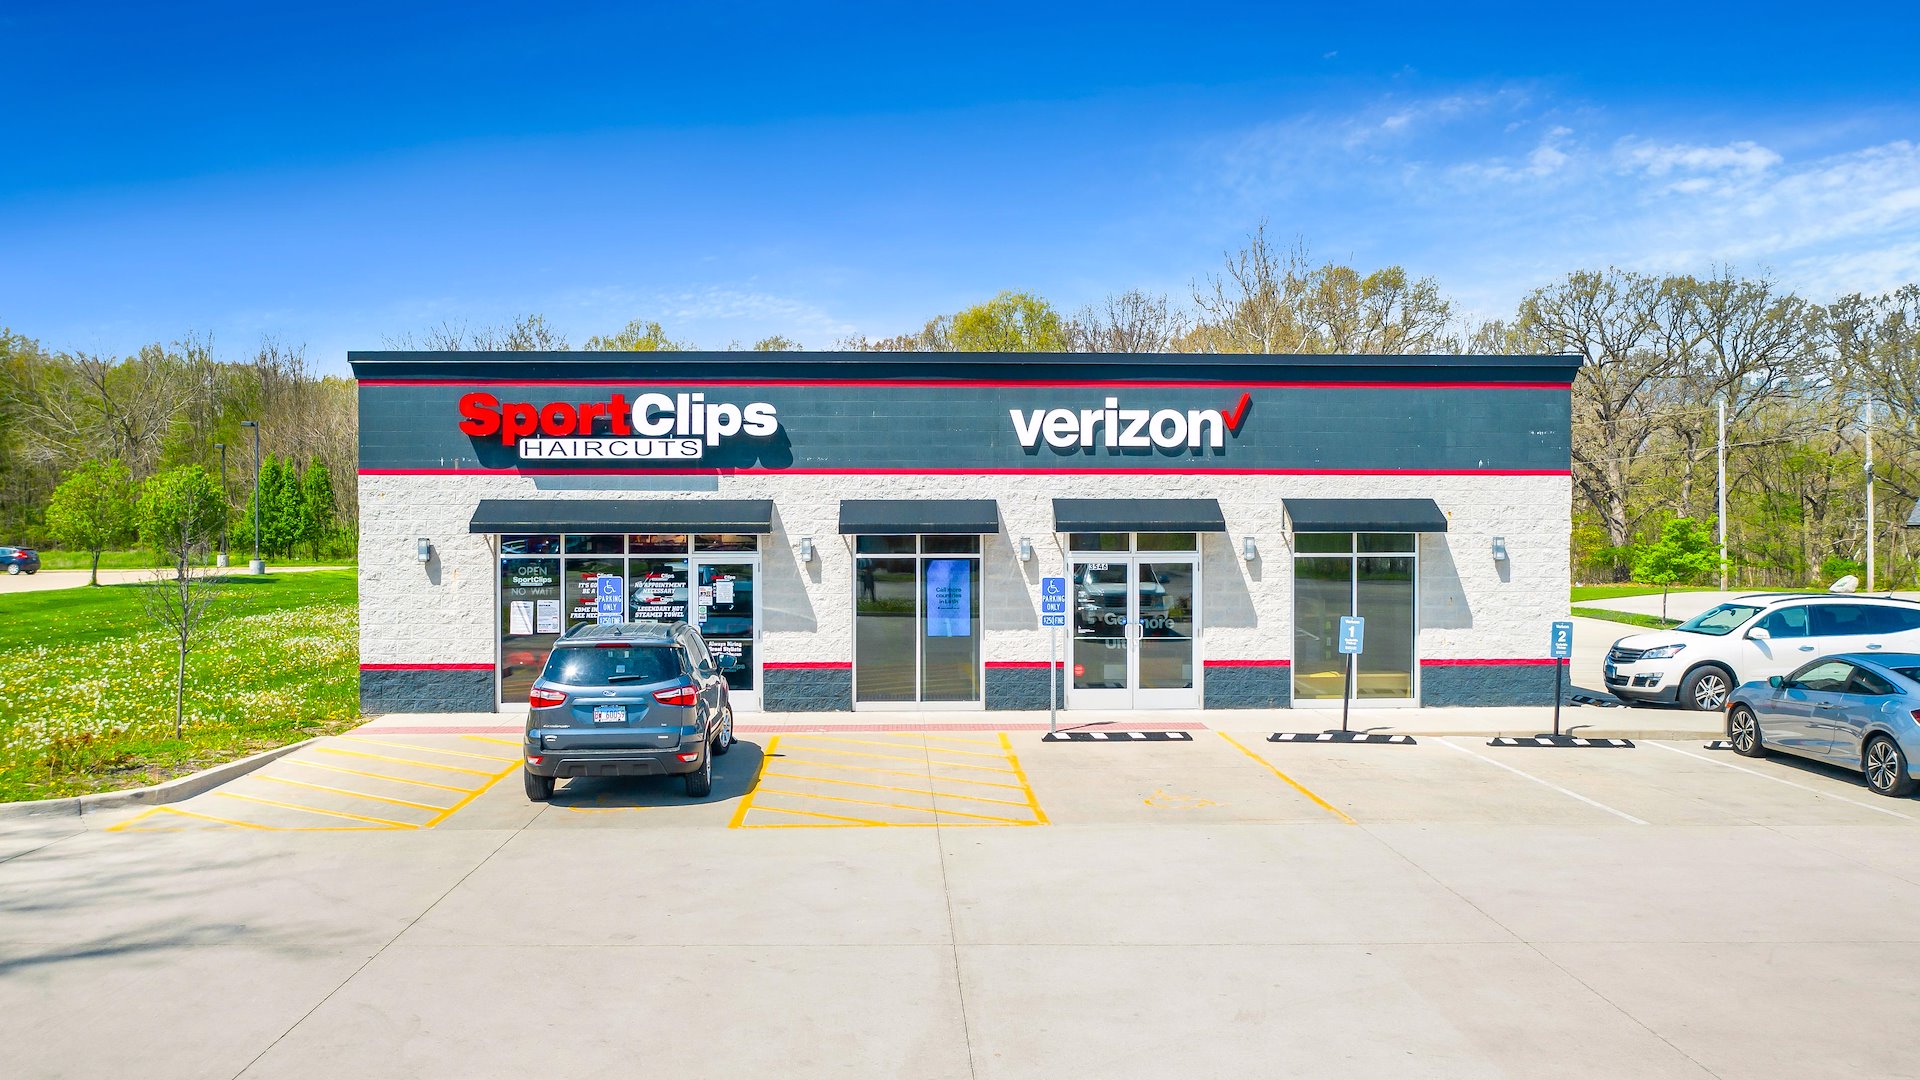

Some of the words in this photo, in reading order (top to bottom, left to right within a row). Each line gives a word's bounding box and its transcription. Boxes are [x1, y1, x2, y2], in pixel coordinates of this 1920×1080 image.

[459, 393, 778, 446] SportClips
[1009, 397, 1224, 447] verizon
[524, 441, 699, 456] HAIRCUTS
[518, 566, 548, 576] OPEN
[512, 576, 553, 584] SportClips
[1047, 603, 1060, 611] ONLY
[1348, 626, 1354, 638] 1
[1558, 630, 1566, 642] 2
